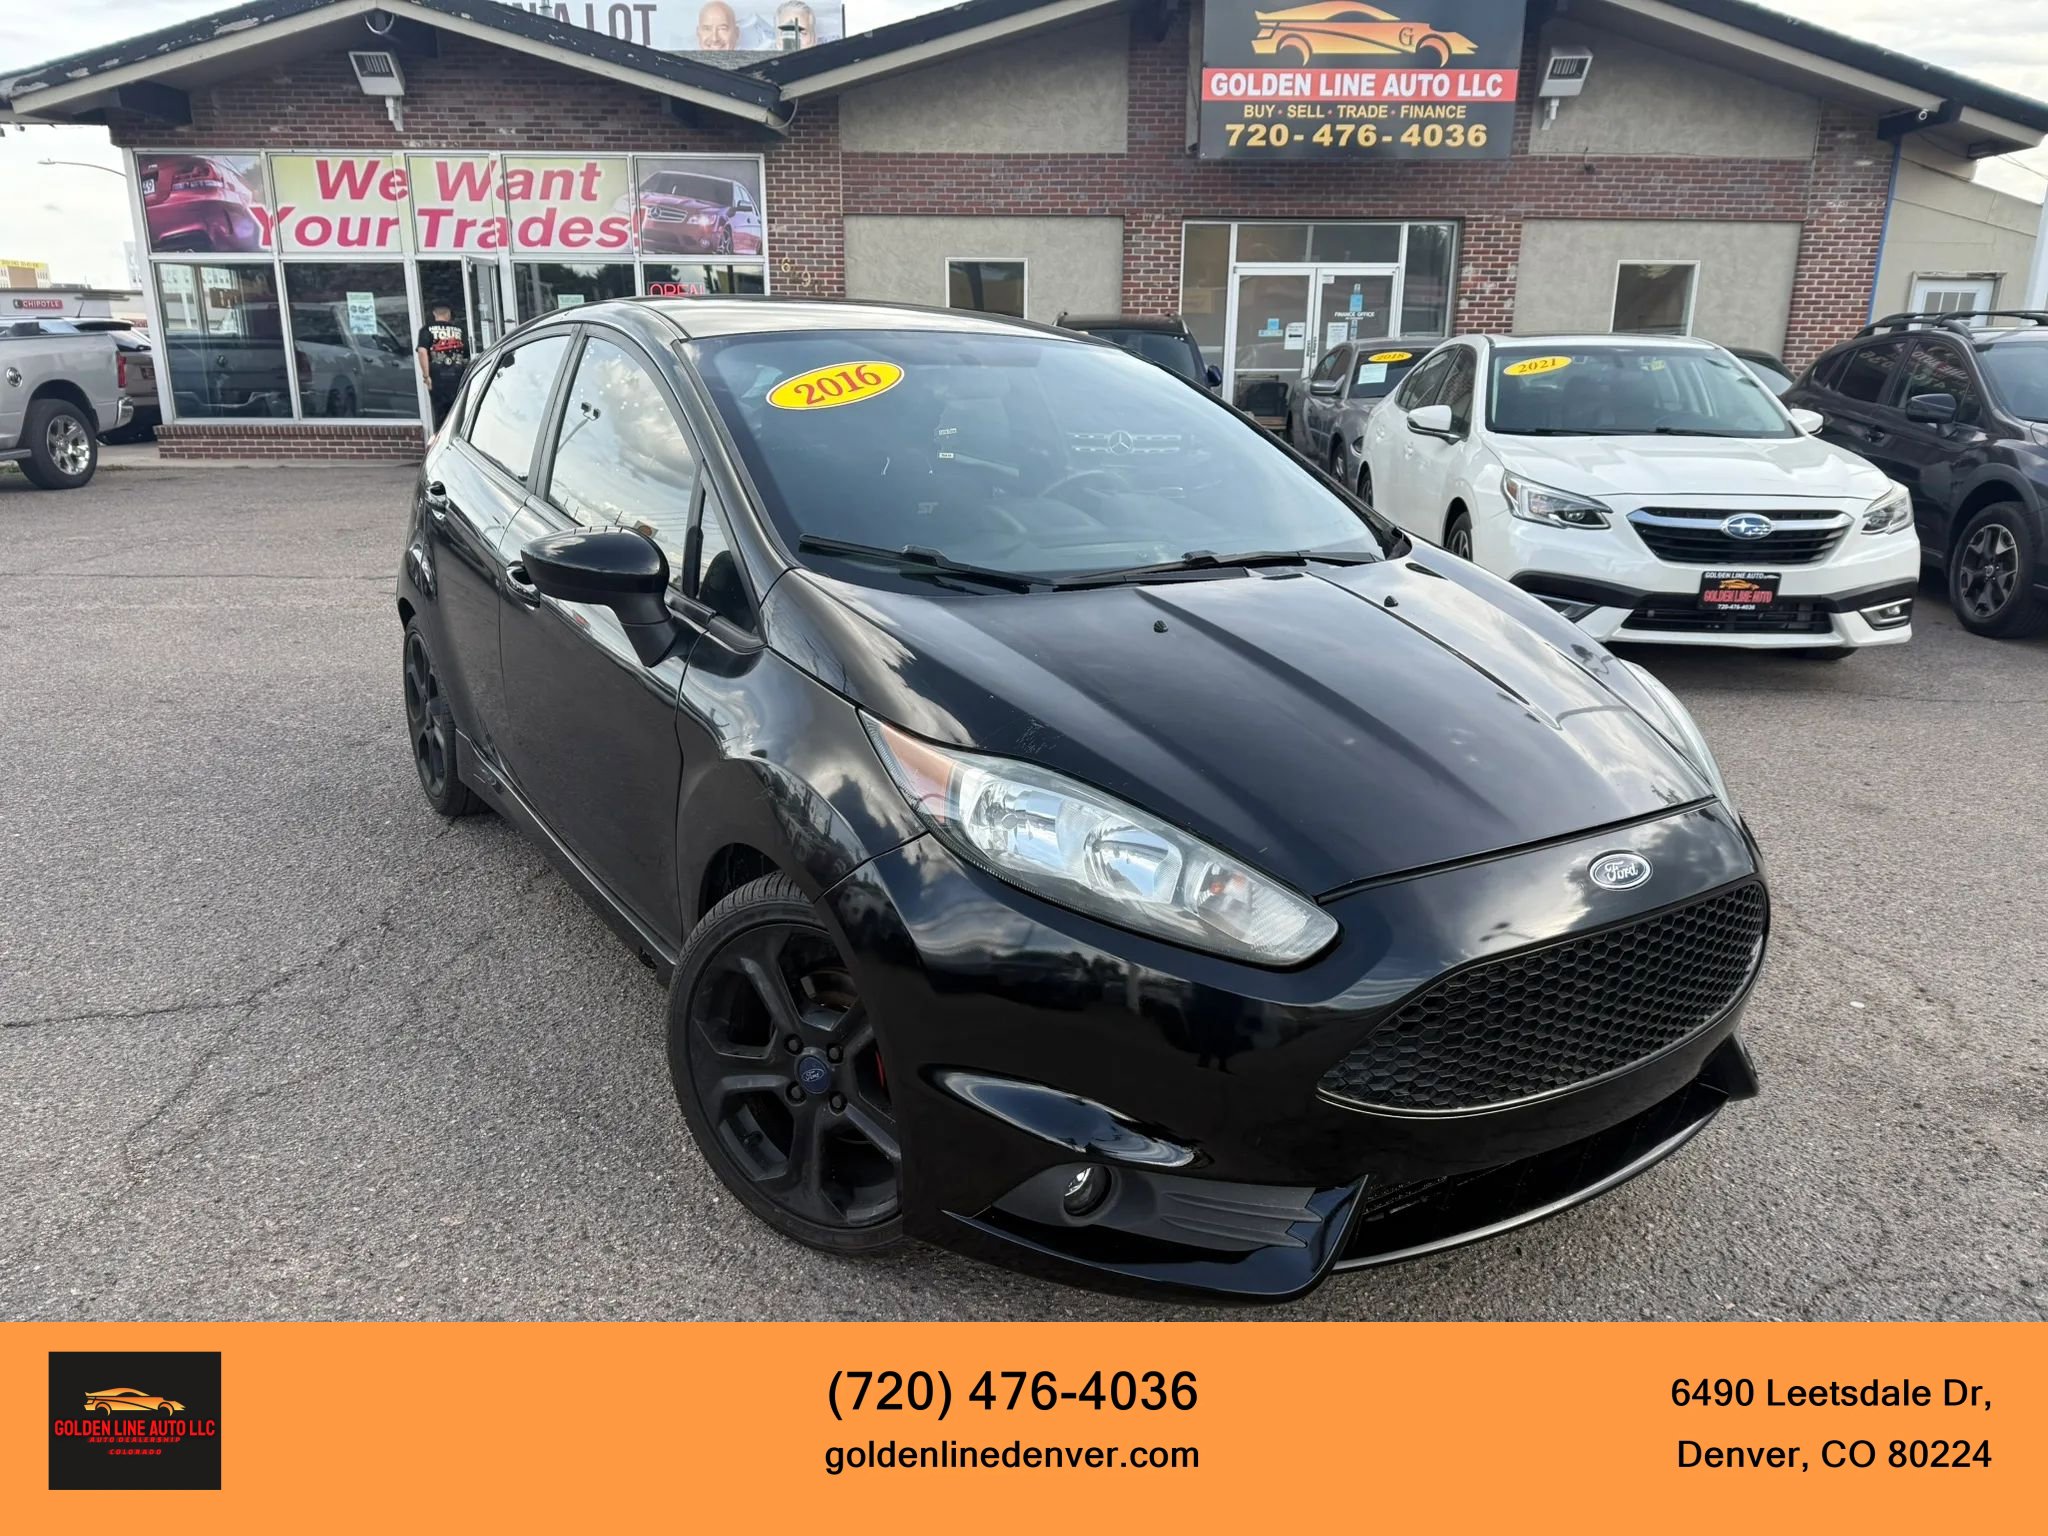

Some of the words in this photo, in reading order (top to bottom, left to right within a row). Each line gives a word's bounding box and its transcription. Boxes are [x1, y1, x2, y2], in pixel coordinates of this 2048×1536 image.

[1398, 26, 1413, 46] G
[1210, 73, 1311, 97] GOLDEN
[1322, 73, 1377, 97] LINE
[1382, 74, 1450, 97] AUTO
[1457, 74, 1503, 98] LLC
[1244, 105, 1275, 118] BUY
[1287, 105, 1325, 118] SELL
[1337, 105, 1388, 119] TRADE
[1400, 105, 1467, 119] FINANCE
[315, 160, 408, 200] We
[435, 160, 603, 201] Want
[250, 206, 400, 247] Your
[417, 208, 647, 248] Trades!
[1518, 358, 1557, 373] 2021
[794, 364, 882, 405] 2016
[1704, 590, 1734, 602] GOLDEN
[1734, 590, 1751, 603] LINE
[1752, 591, 1773, 603] AUTO
[1604, 860, 1639, 882] Ford
